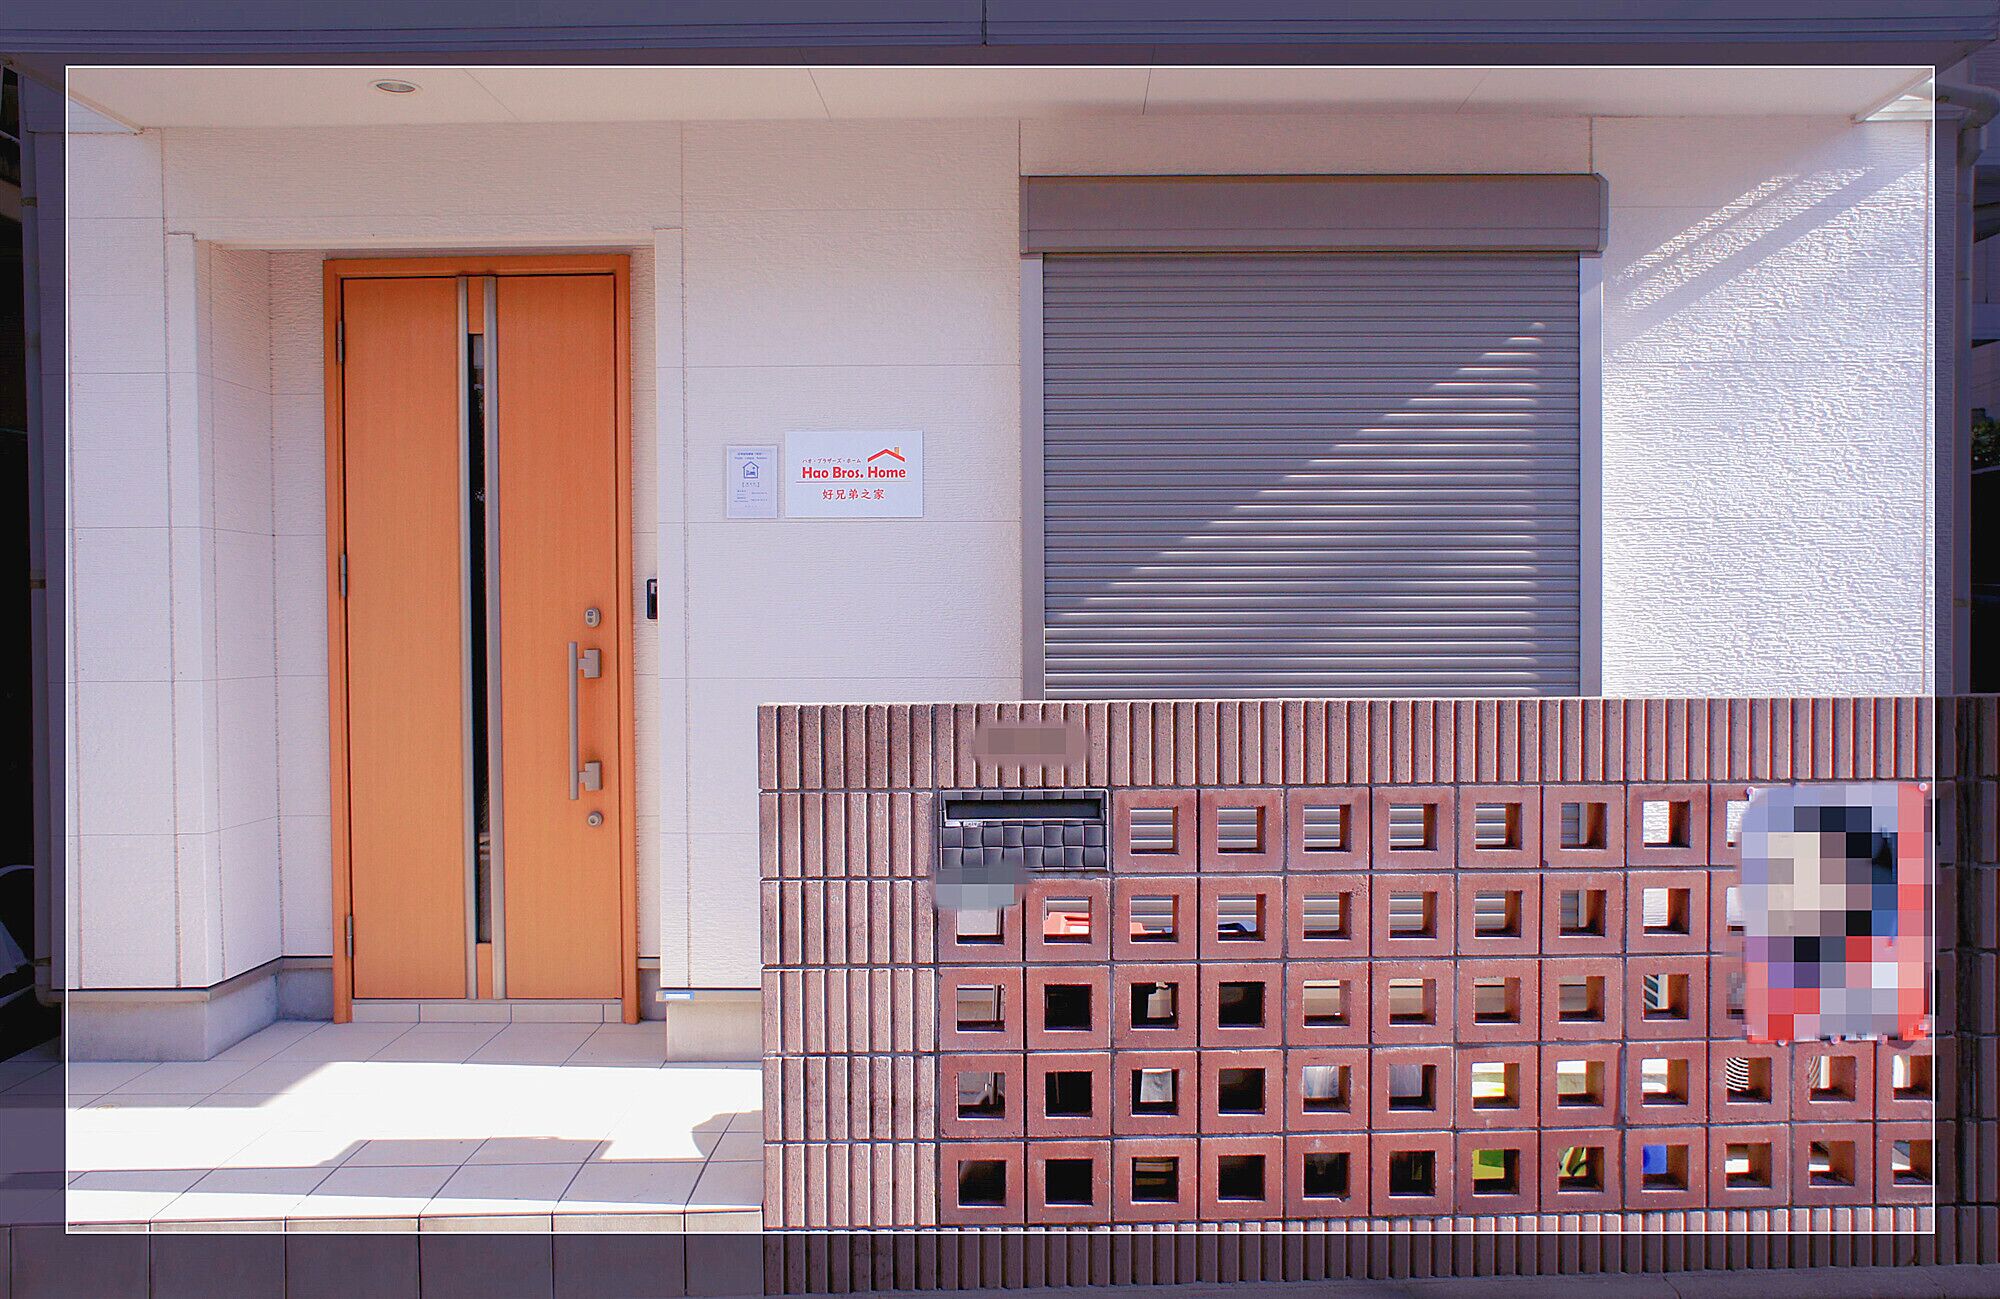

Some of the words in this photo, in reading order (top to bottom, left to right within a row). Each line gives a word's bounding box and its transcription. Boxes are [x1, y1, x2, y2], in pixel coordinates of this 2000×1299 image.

[802, 466, 829, 479] Hao
[832, 466, 864, 478] Bros.
[867, 466, 906, 478] Home
[822, 488, 885, 500] 好兄弟之家
